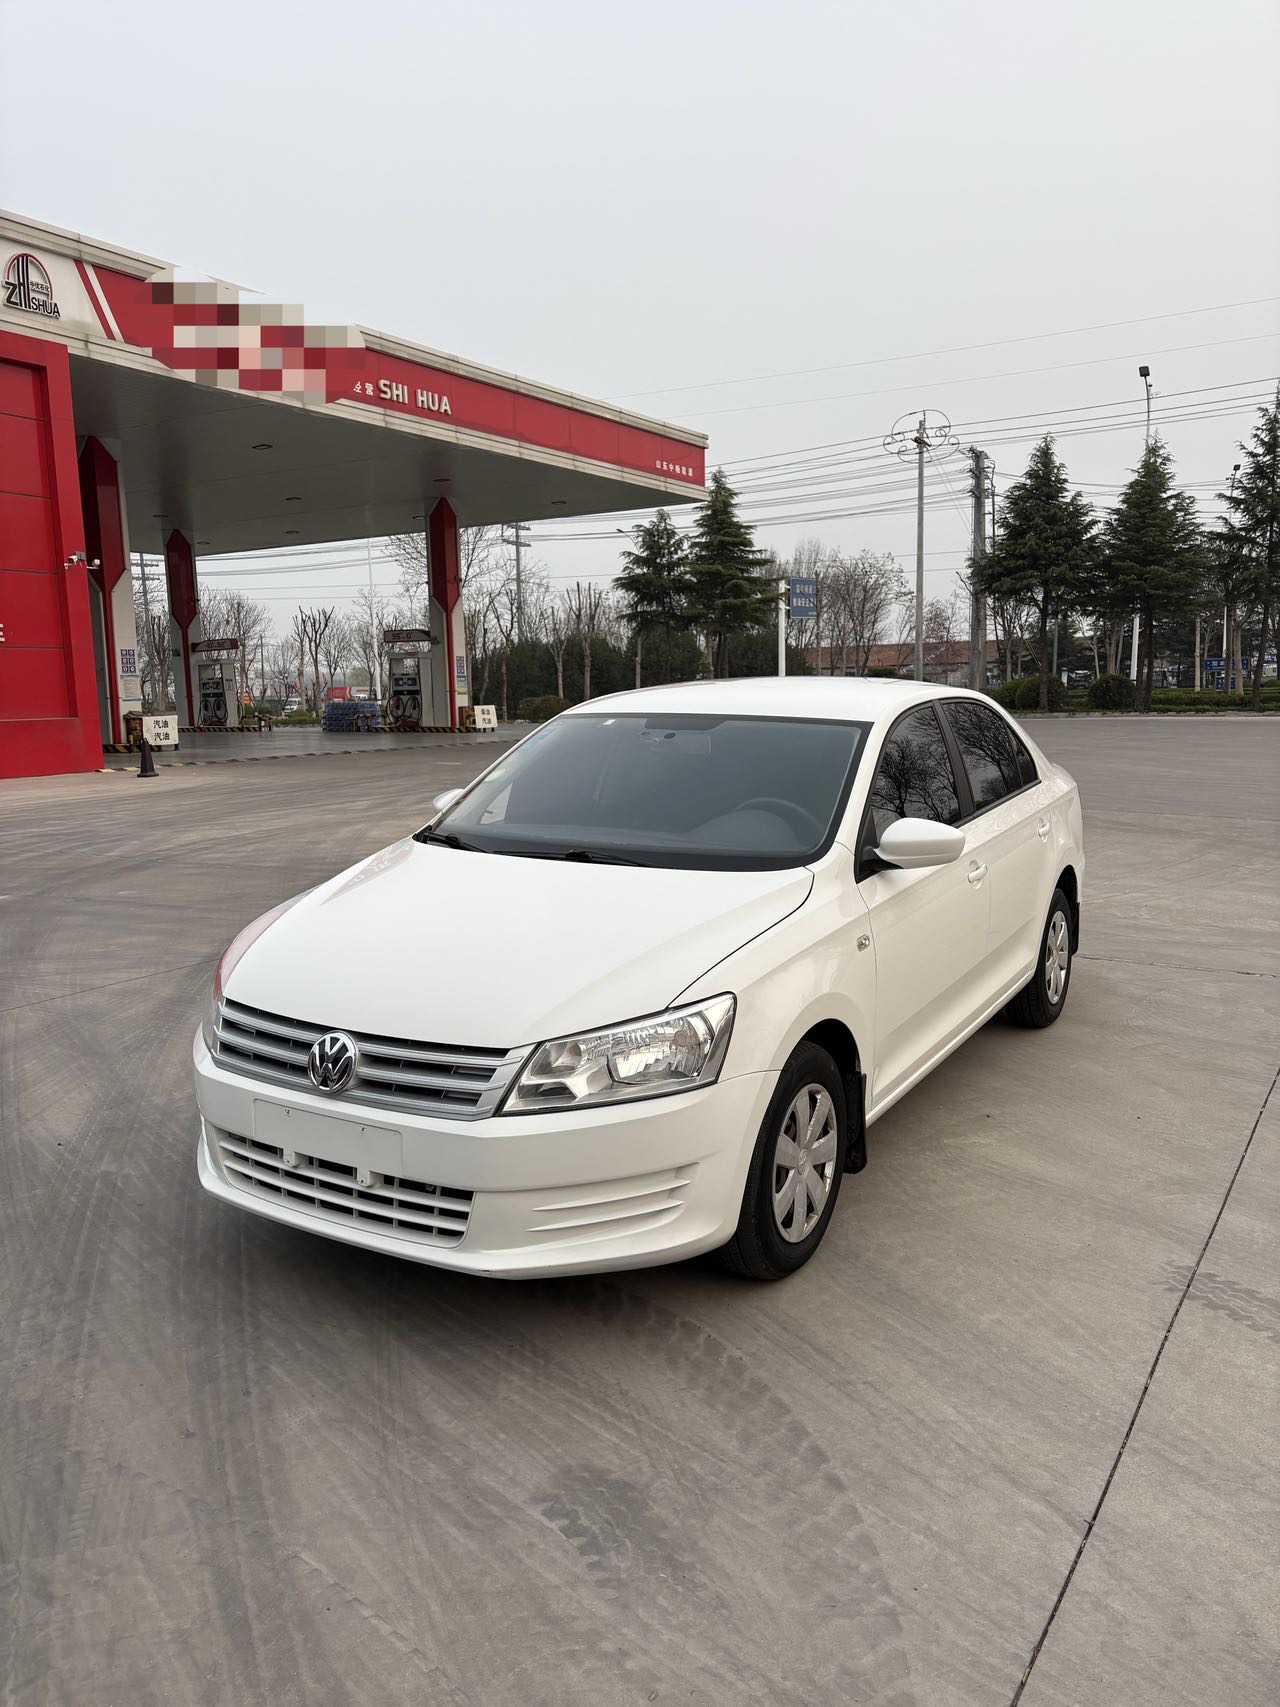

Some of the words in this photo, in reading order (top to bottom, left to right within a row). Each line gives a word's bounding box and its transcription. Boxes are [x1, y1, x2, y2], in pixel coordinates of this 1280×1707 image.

[378, 379, 408, 404] SHI
[416, 388, 452, 415] HUA
[153, 719, 169, 729] 汽油
[154, 732, 170, 741] 汽油
